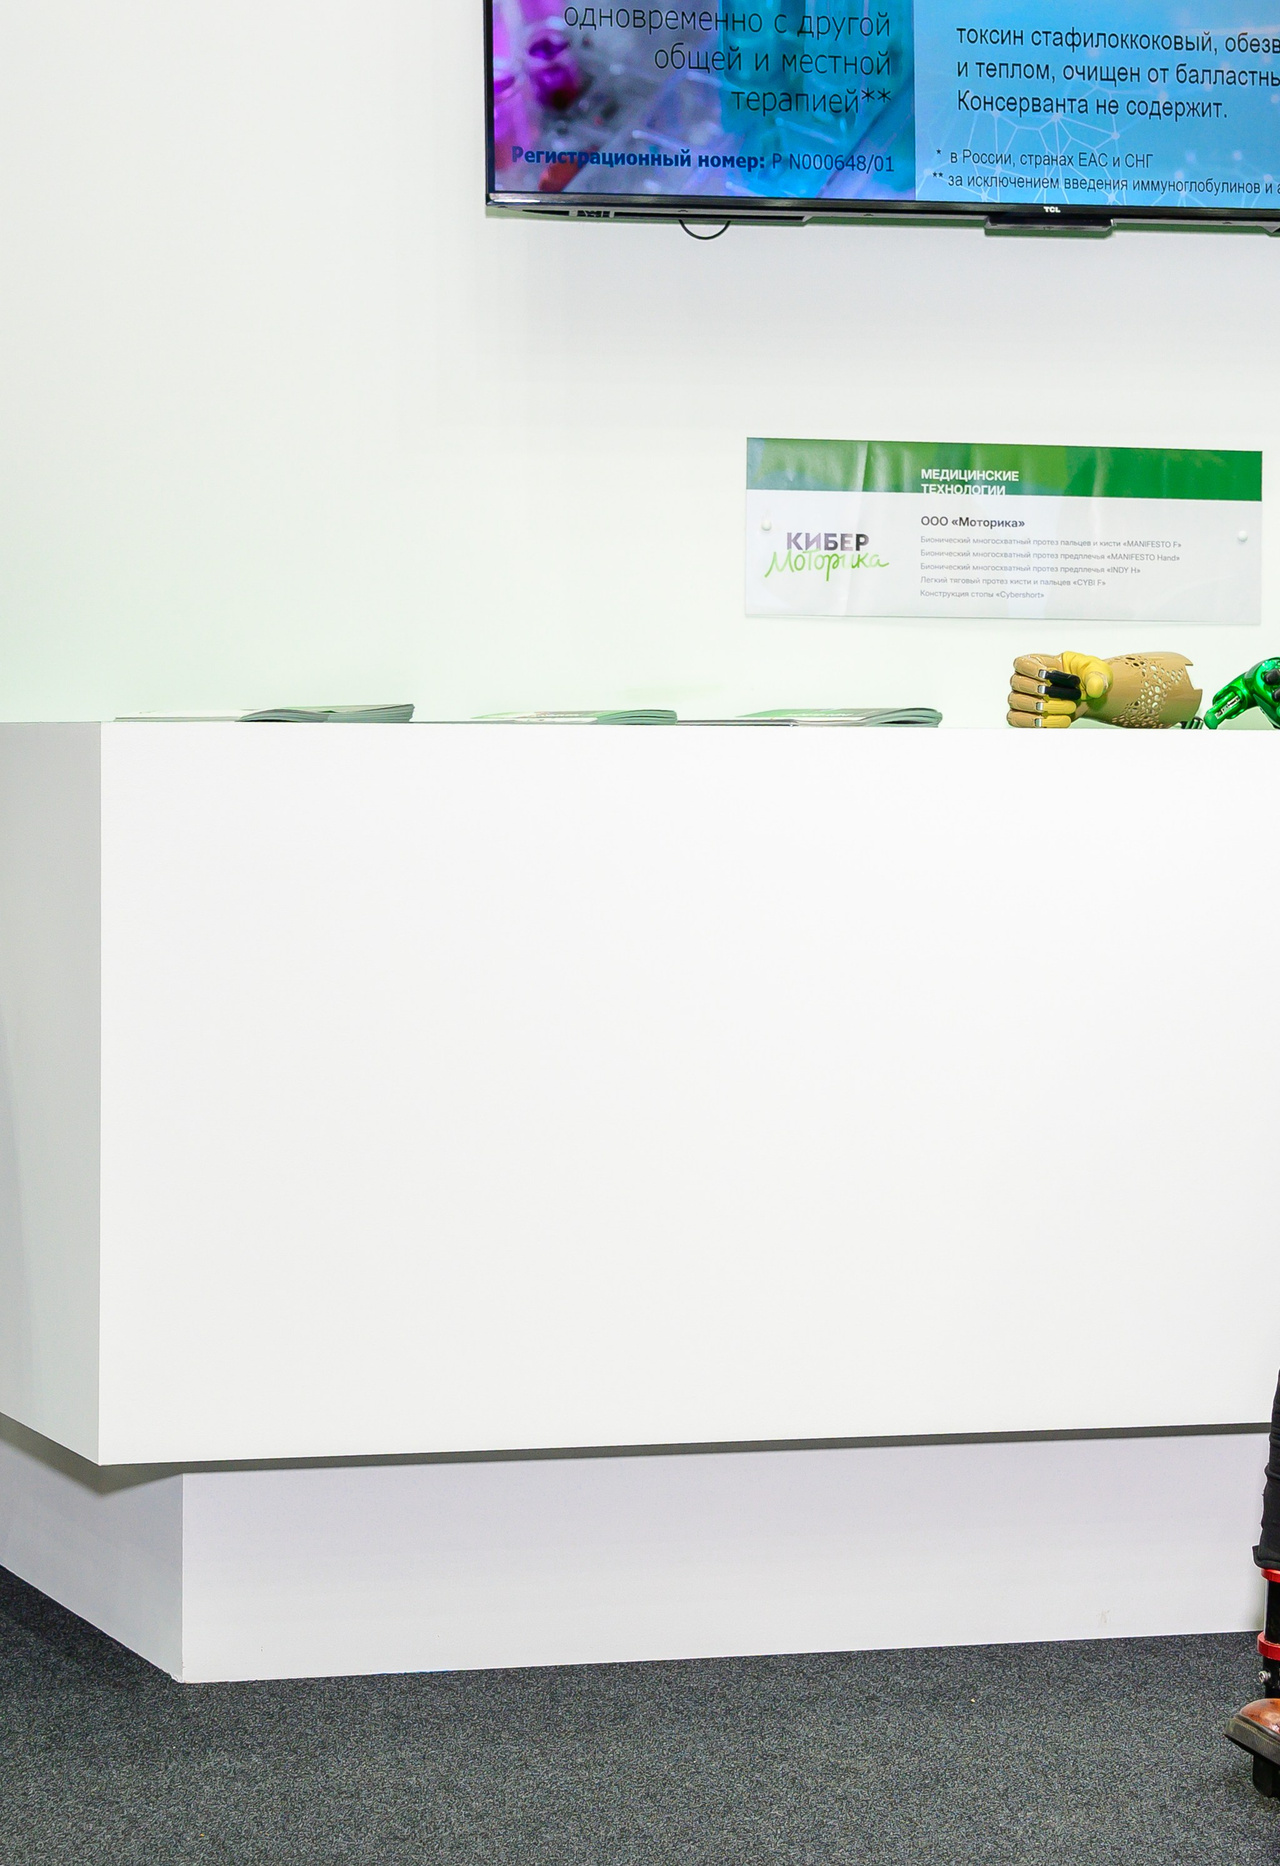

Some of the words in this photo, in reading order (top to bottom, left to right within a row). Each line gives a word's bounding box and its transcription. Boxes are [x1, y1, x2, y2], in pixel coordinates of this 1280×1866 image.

[563, 6, 763, 35] одновременно
[774, 14, 787, 33] с
[797, 11, 891, 41] другой
[956, 27, 1024, 46] токсин
[1031, 27, 1218, 55] стафилоккоковый,
[654, 42, 743, 74] общей
[755, 53, 769, 71] и
[782, 50, 891, 75] местной
[957, 61, 968, 77] и
[976, 61, 1056, 82] теплом,
[1063, 64, 1140, 87] очищен
[1147, 67, 1169, 83] от
[957, 89, 1088, 118] Консерванта
[1096, 99, 1119, 115] не
[1126, 100, 1227, 122] содержит.
[511, 145, 692, 169] Регистрационный
[698, 155, 765, 173] номер:
[789, 154, 894, 174] N000648/01
[950, 152, 958, 164] в
[962, 148, 1016, 169] России,
[1020, 153, 1074, 173] странах
[1078, 152, 1109, 168] ЕАС
[1112, 155, 1121, 167] и
[1124, 153, 1154, 169] СНГ
[948, 175, 963, 187] за
[967, 174, 1060, 189] исключением
[1064, 177, 1127, 193] введения
[1132, 178, 1261, 196] иммуноглобулинов
[1265, 183, 1273, 194] и
[920, 468, 1020, 482] МЕДИЦИНСКИЕ
[920, 483, 1006, 496] ТЕХНОЛОГИИ
[920, 516, 949, 526] ООО
[951, 516, 1025, 529] «Моторика»
[786, 532, 870, 551] КИБЕР
[920, 535, 971, 544] Бионический
[972, 538, 1031, 546] многосхватный
[1032, 539, 1059, 547] протез
[1060, 539, 1091, 548] пальцев
[1122, 540, 1171, 549] «MANIFESTO
[764, 549, 889, 582] Моторика
[920, 549, 971, 558] Бионический
[972, 551, 1031, 560] многосхватный
[1032, 553, 1059, 561] протез
[1060, 553, 1105, 562] предплечья
[1106, 553, 1155, 561] «MANIFESTO
[920, 562, 971, 571] Бионический
[972, 564, 1031, 573] многосхватный
[1032, 566, 1059, 574] протез
[1060, 567, 1105, 575] предплечья
[950, 577, 980, 585] тяговый
[982, 578, 1008, 586] протез
[1040, 579, 1071, 587] пальцев
[920, 589, 969, 598] Конструкция
